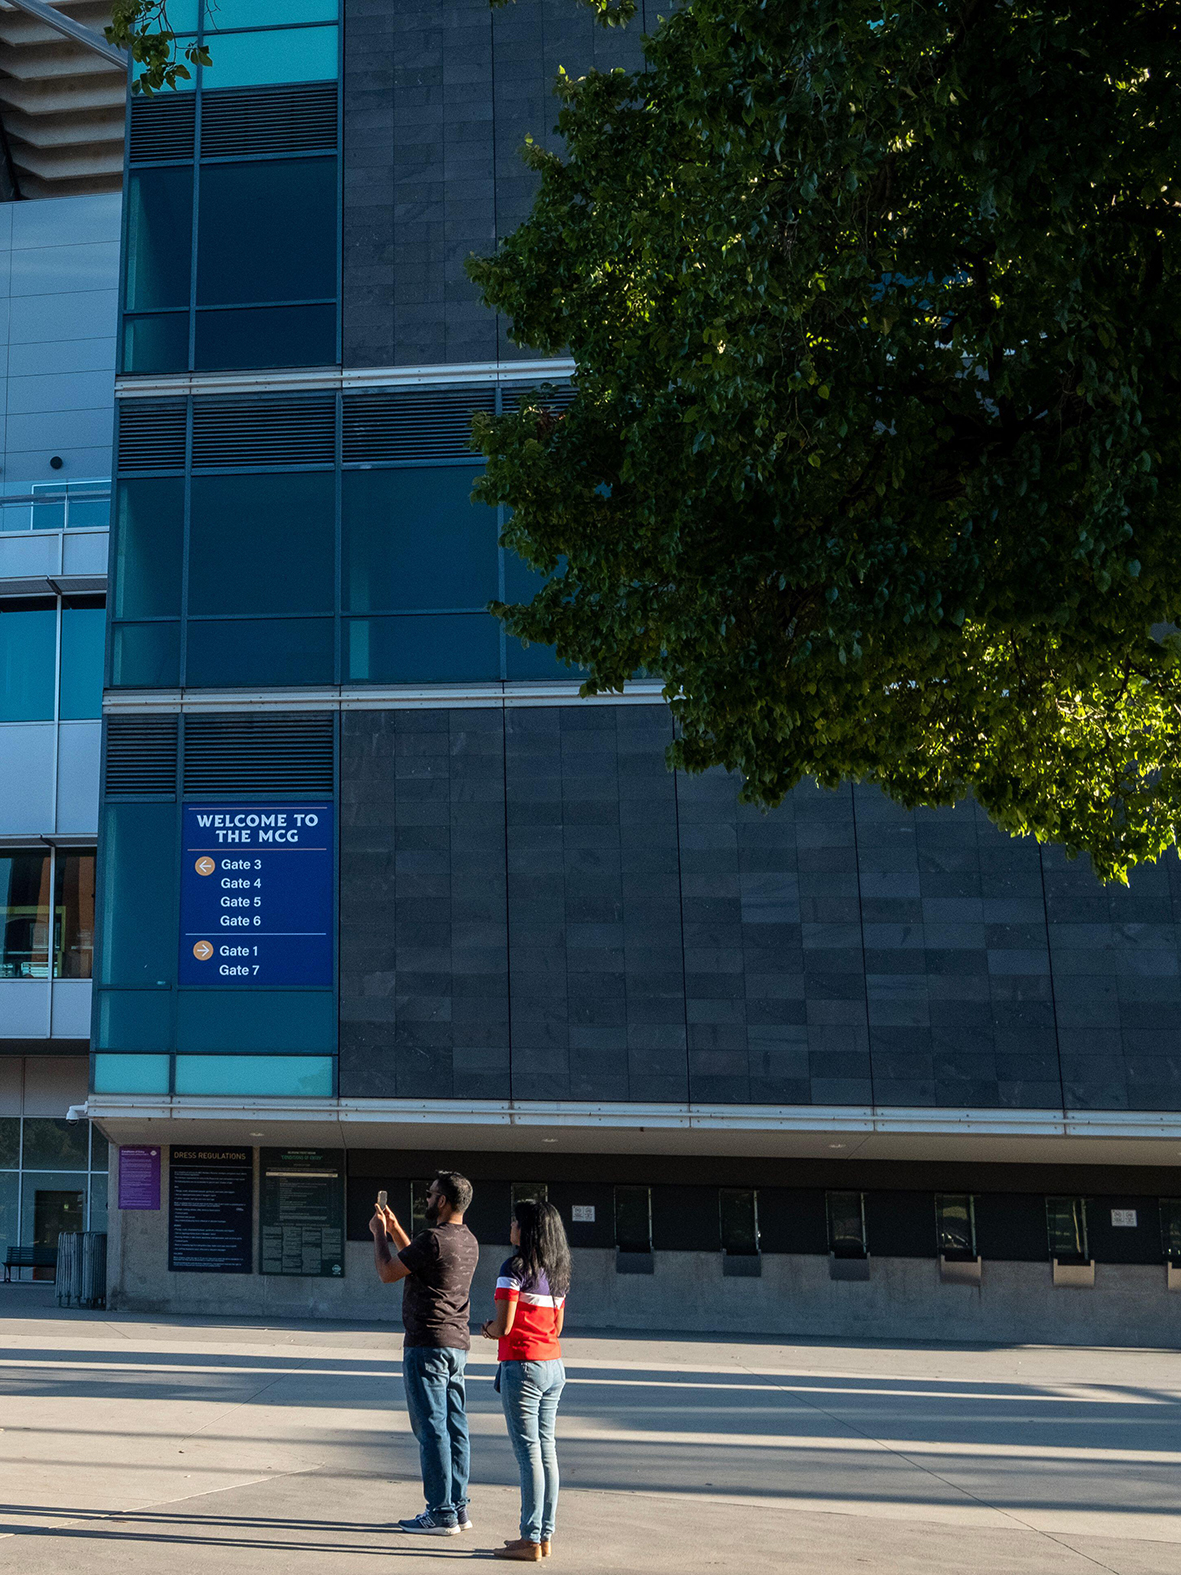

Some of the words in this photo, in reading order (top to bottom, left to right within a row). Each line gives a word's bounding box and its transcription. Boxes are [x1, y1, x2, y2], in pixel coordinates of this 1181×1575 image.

[197, 814, 287, 827] WELCOME
[294, 814, 319, 827] TO
[216, 830, 251, 843] THE
[259, 829, 299, 843] MCG
[221, 859, 251, 870] Gate
[254, 859, 262, 870] 3
[221, 878, 250, 889] Gate
[253, 878, 262, 889] 4
[220, 896, 250, 907] Gate
[253, 896, 261, 907] 5
[220, 915, 250, 926] Gate
[253, 915, 261, 926] 6
[219, 945, 249, 956] Gate
[252, 945, 258, 956] 1
[219, 964, 249, 976] Gate
[252, 964, 260, 976] 7
[174, 1151, 197, 1159] DRESS
[198, 1152, 247, 1161] REGULATIONS
